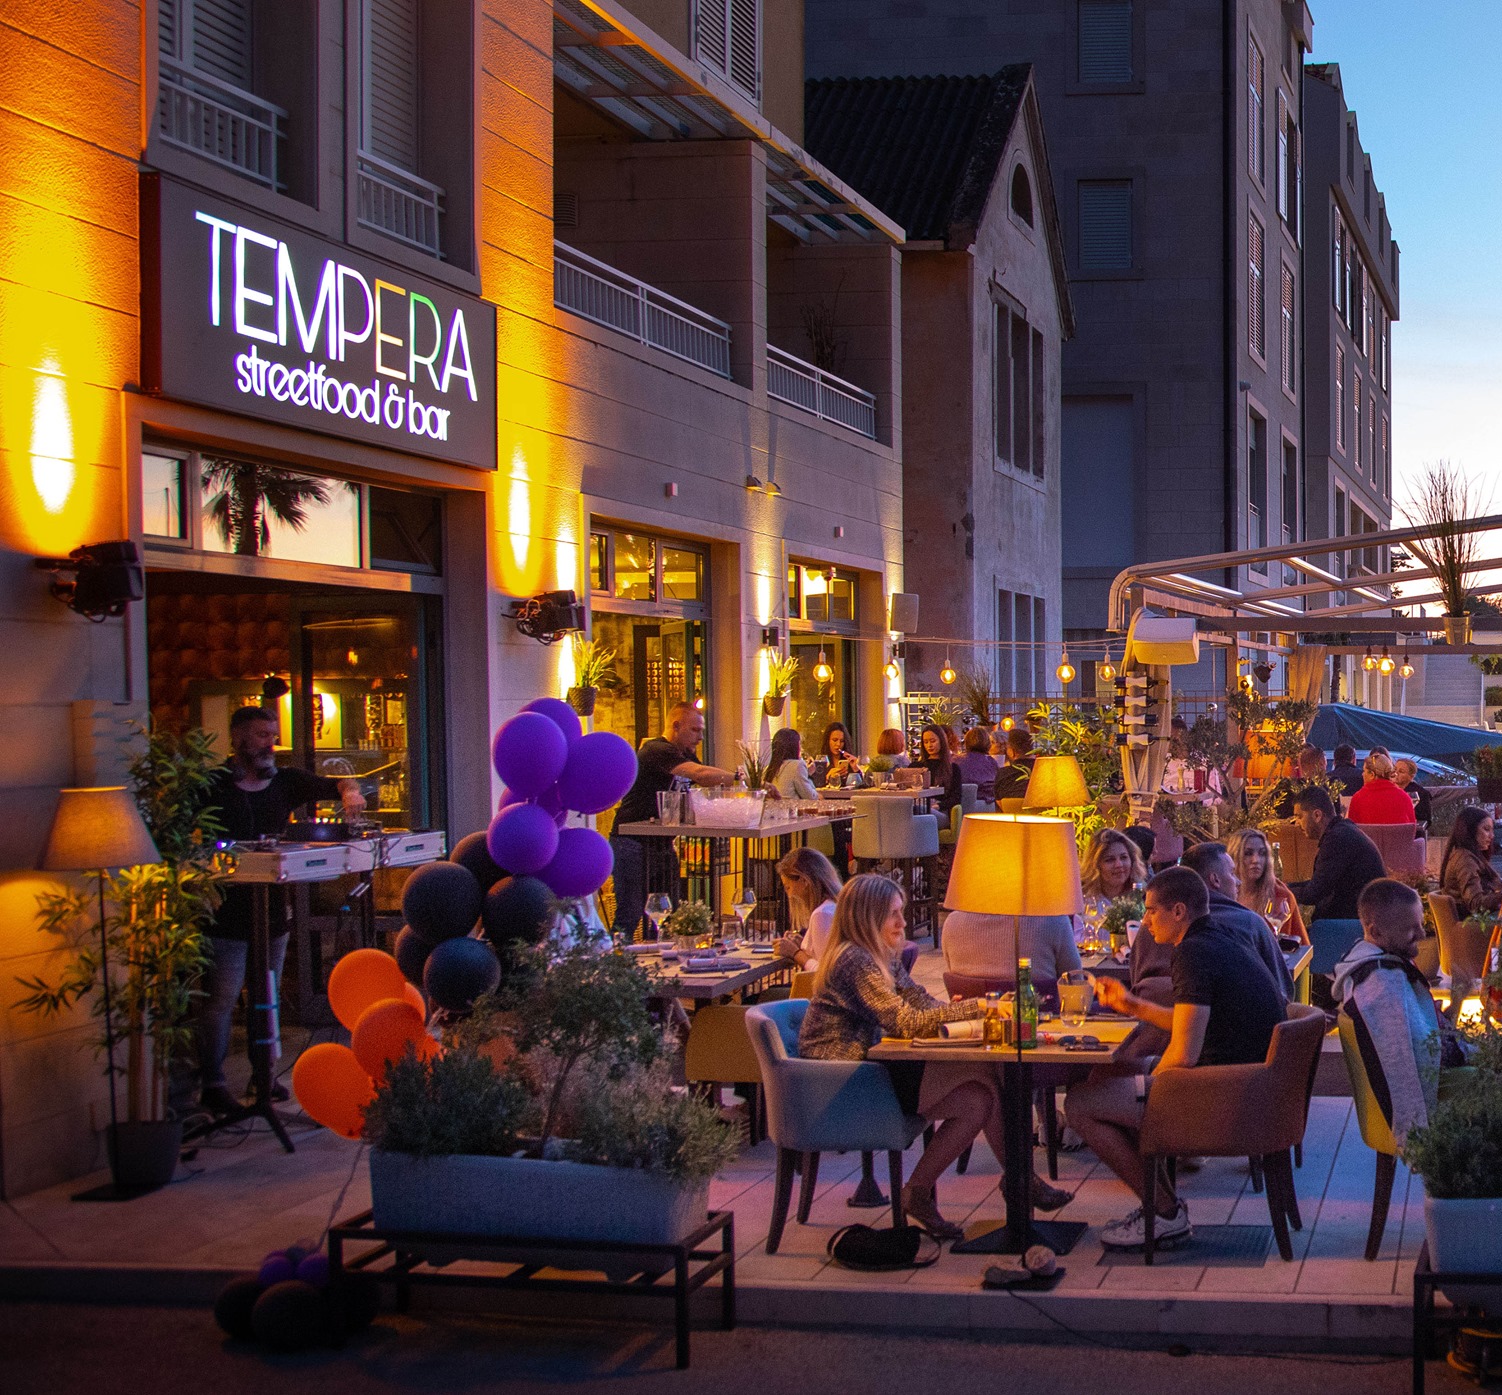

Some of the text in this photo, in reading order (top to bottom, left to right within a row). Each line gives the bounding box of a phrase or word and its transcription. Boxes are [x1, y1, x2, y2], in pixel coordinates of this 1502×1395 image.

[194, 210, 478, 402] TEMPERA
[234, 344, 451, 442] streetfood & bar
